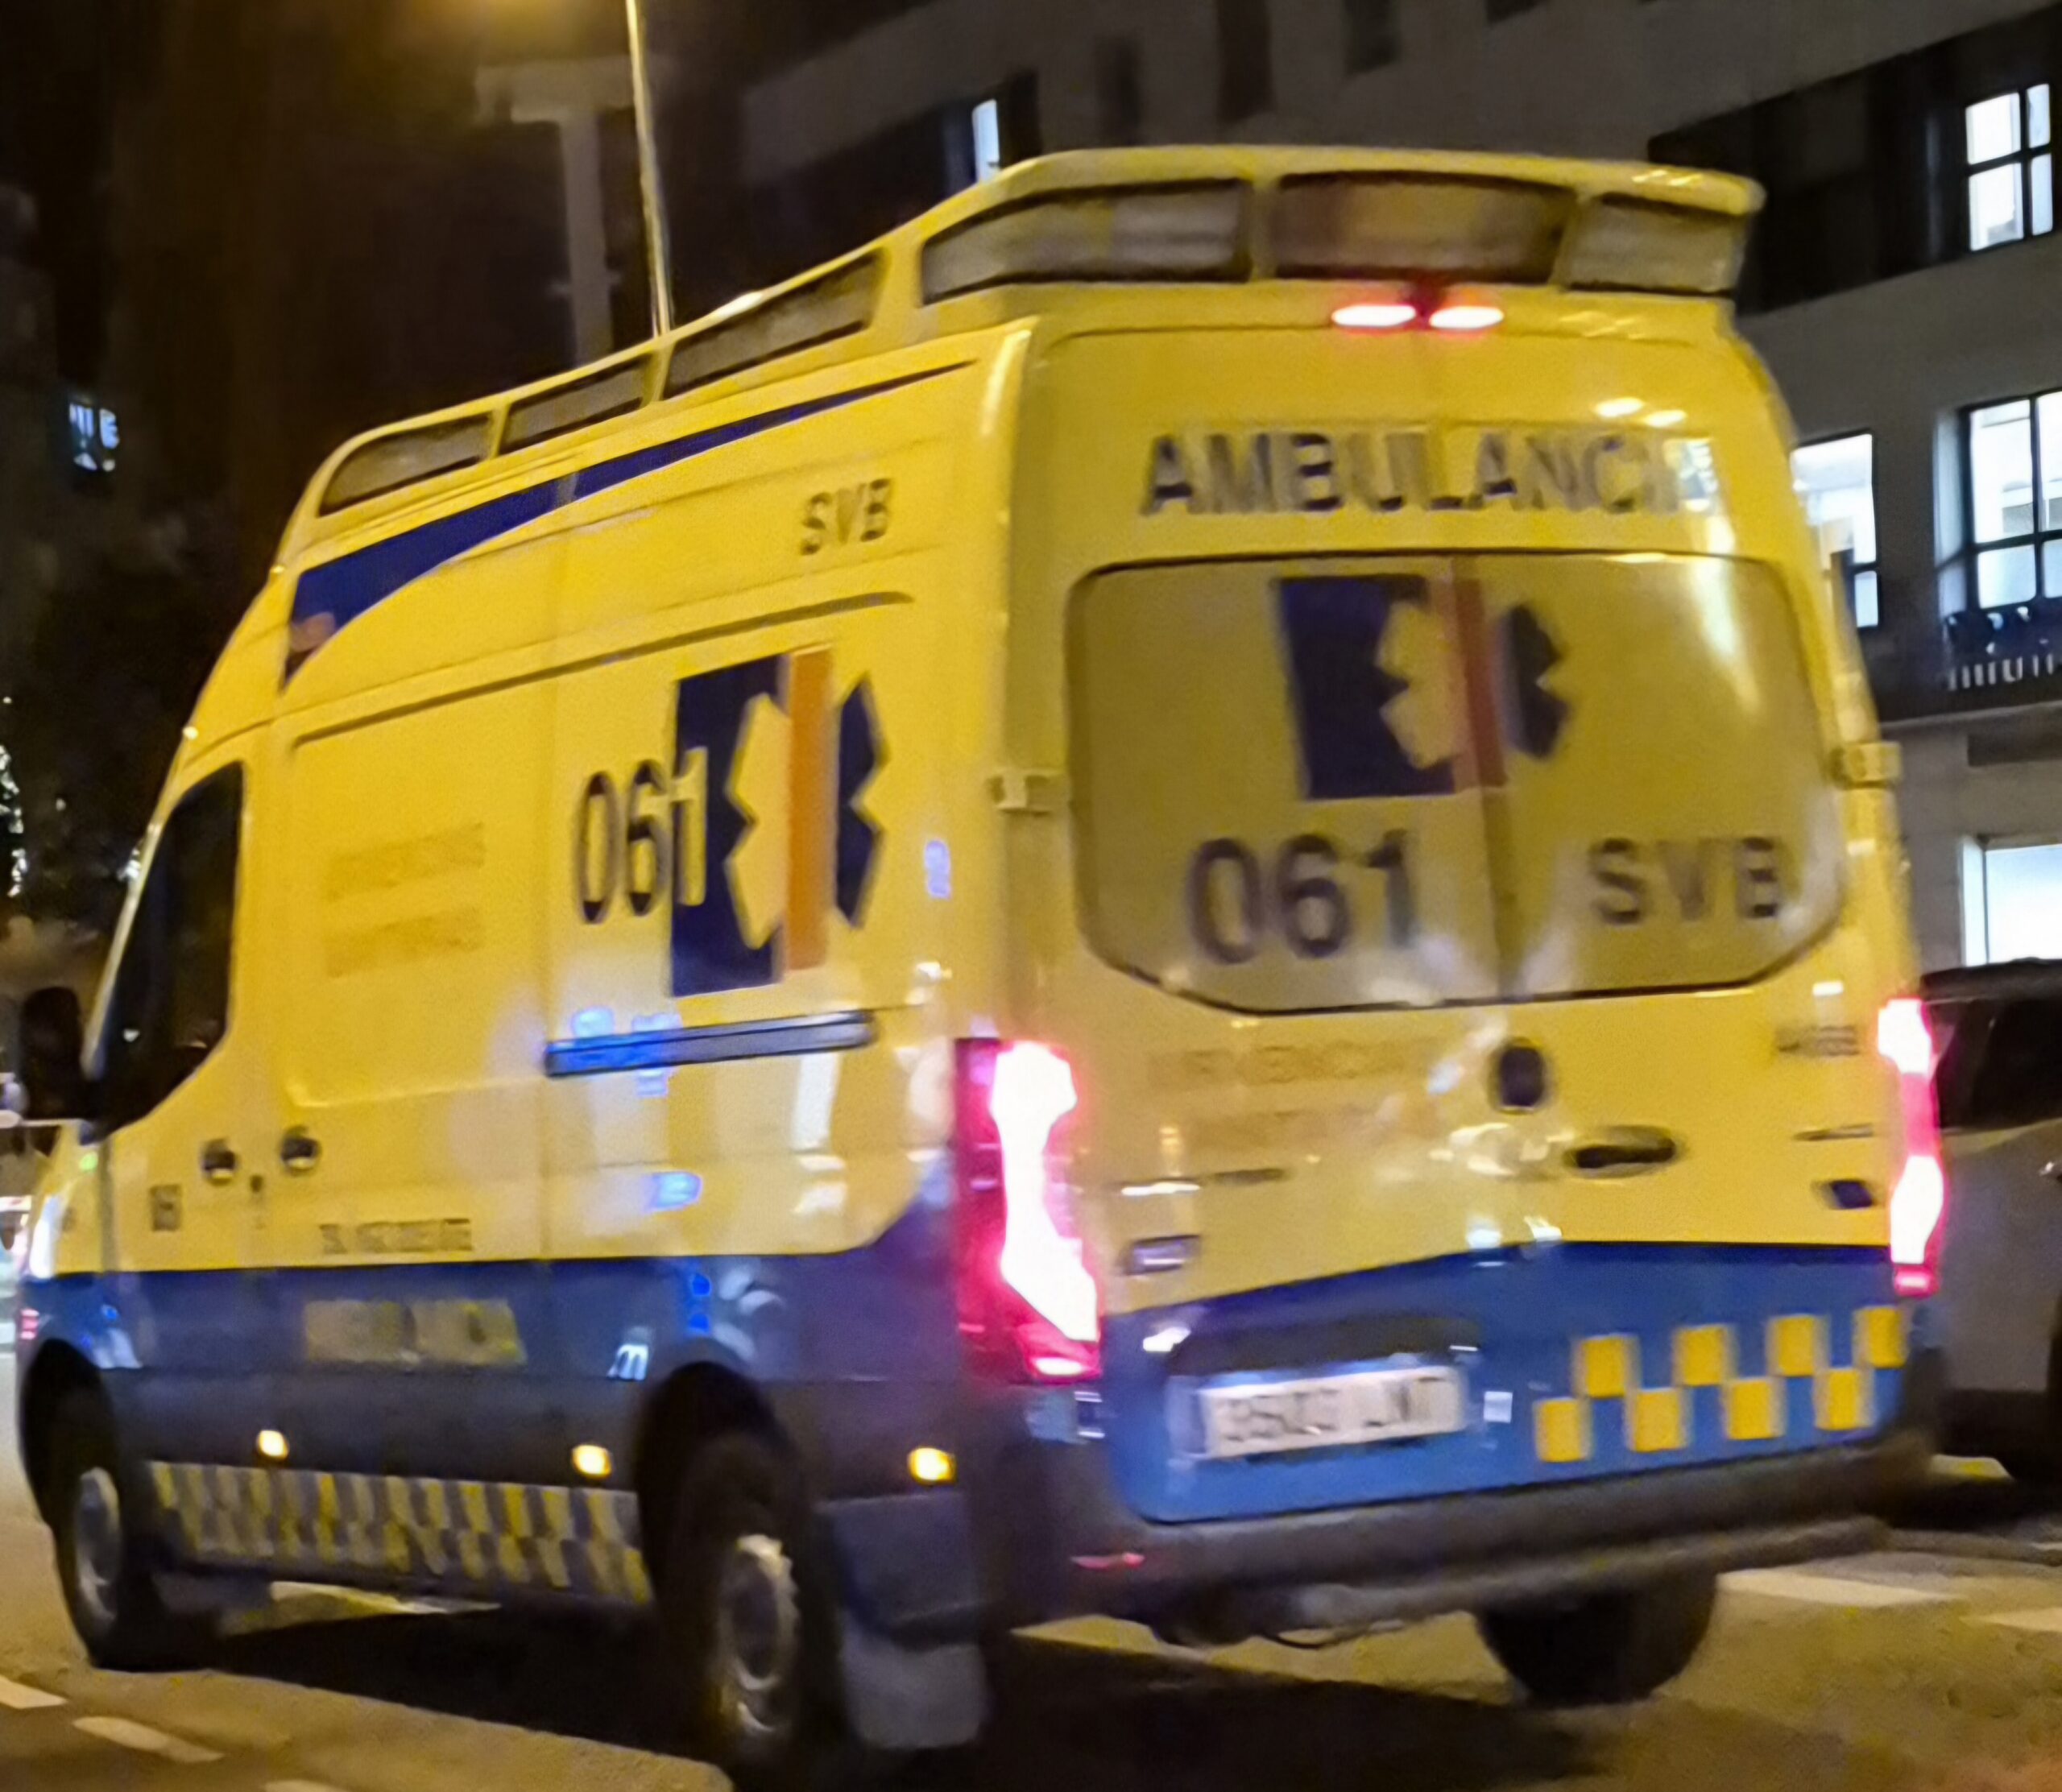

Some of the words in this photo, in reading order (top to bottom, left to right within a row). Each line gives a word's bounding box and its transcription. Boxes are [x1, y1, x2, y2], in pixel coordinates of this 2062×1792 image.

[799, 478, 894, 556] SVB
[573, 745, 710, 925] 061
[1588, 835, 1786, 926] SVB
[1185, 829, 1421, 964] 061
